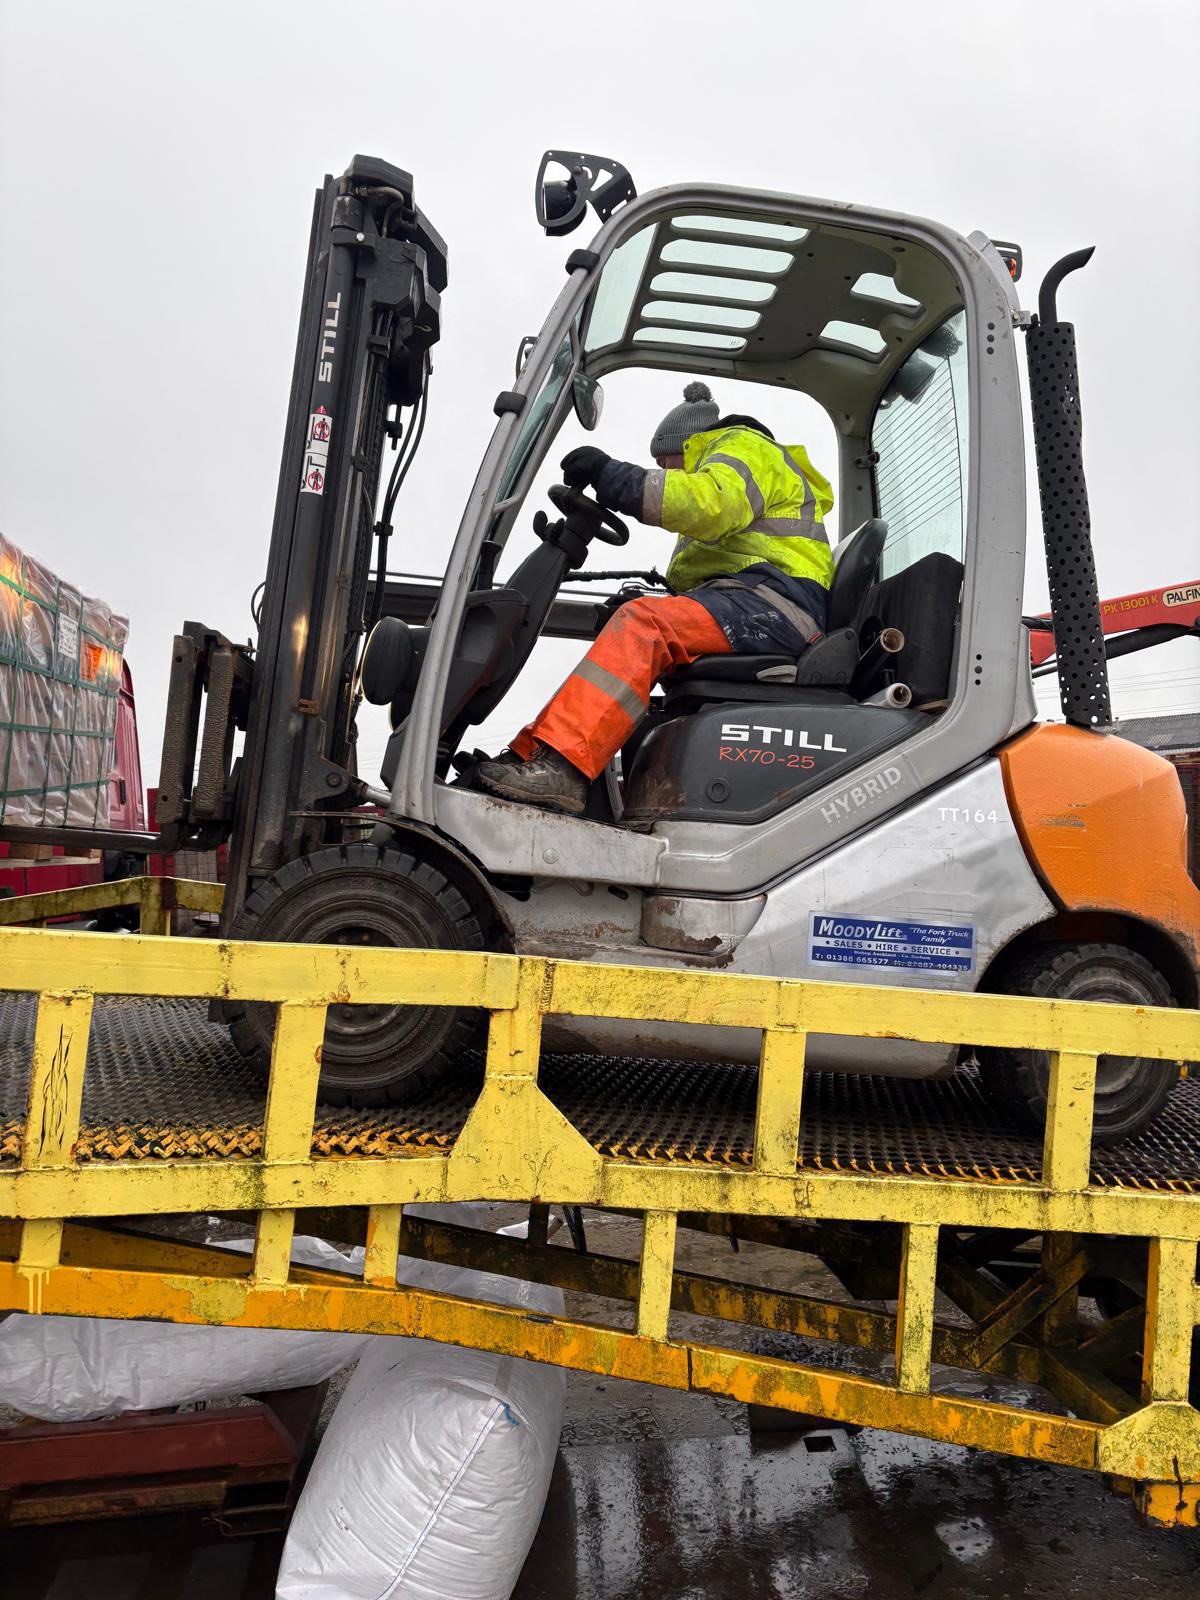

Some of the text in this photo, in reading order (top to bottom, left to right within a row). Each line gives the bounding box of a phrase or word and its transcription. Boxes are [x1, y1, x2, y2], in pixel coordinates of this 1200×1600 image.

[319, 292, 341, 382] STILL
[1103, 594, 1160, 615] PK 13001 K
[721, 724, 847, 752] STILL
[720, 746, 815, 769] RX70-25
[820, 766, 901, 824] HYBRID
[938, 807, 998, 823] TT164
[928, 928, 945, 936] Fork
[948, 930, 969, 938] Truck
[834, 940, 951, 956] SALES HIRE SERVICE
[856, 957, 889, 965] 665577
